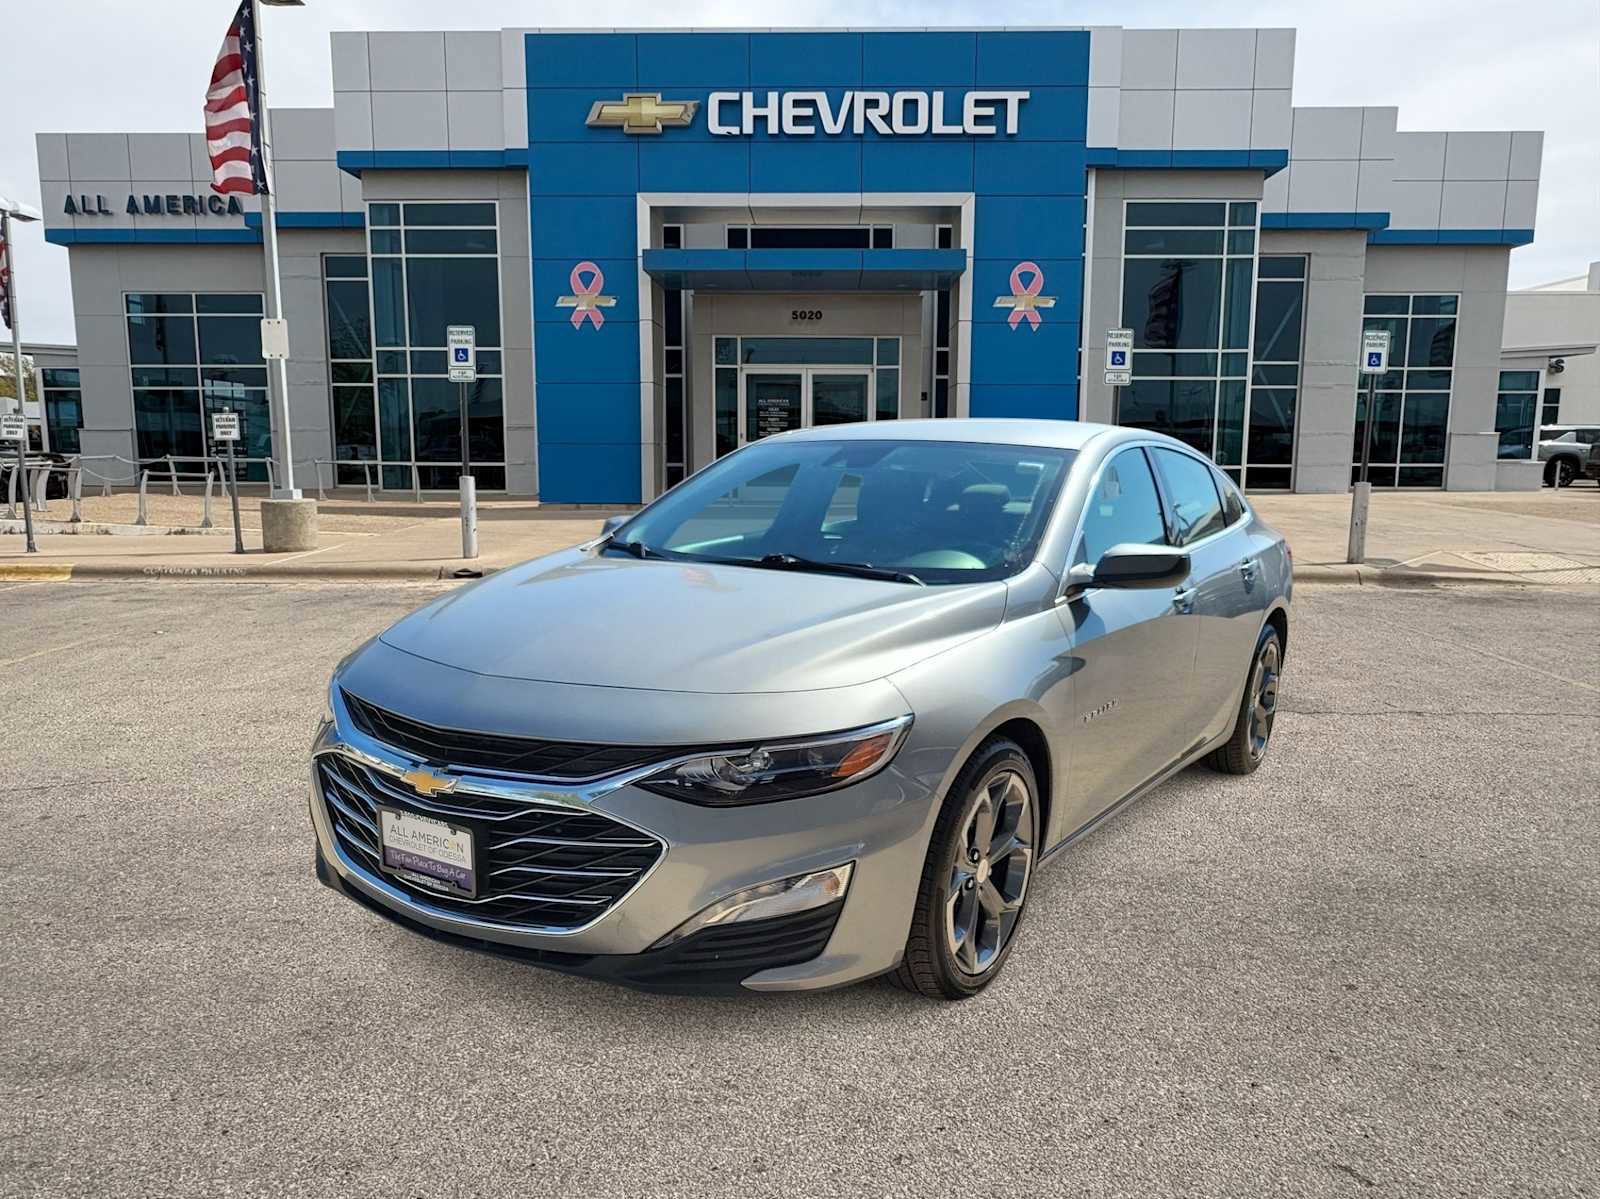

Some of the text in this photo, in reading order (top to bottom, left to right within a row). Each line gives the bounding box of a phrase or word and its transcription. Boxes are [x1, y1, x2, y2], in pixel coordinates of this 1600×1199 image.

[707, 91, 1030, 136] CHEVROLET
[64, 194, 112, 215] ALL
[791, 310, 823, 320] 5020
[390, 824, 464, 853] ALL AMERICN
